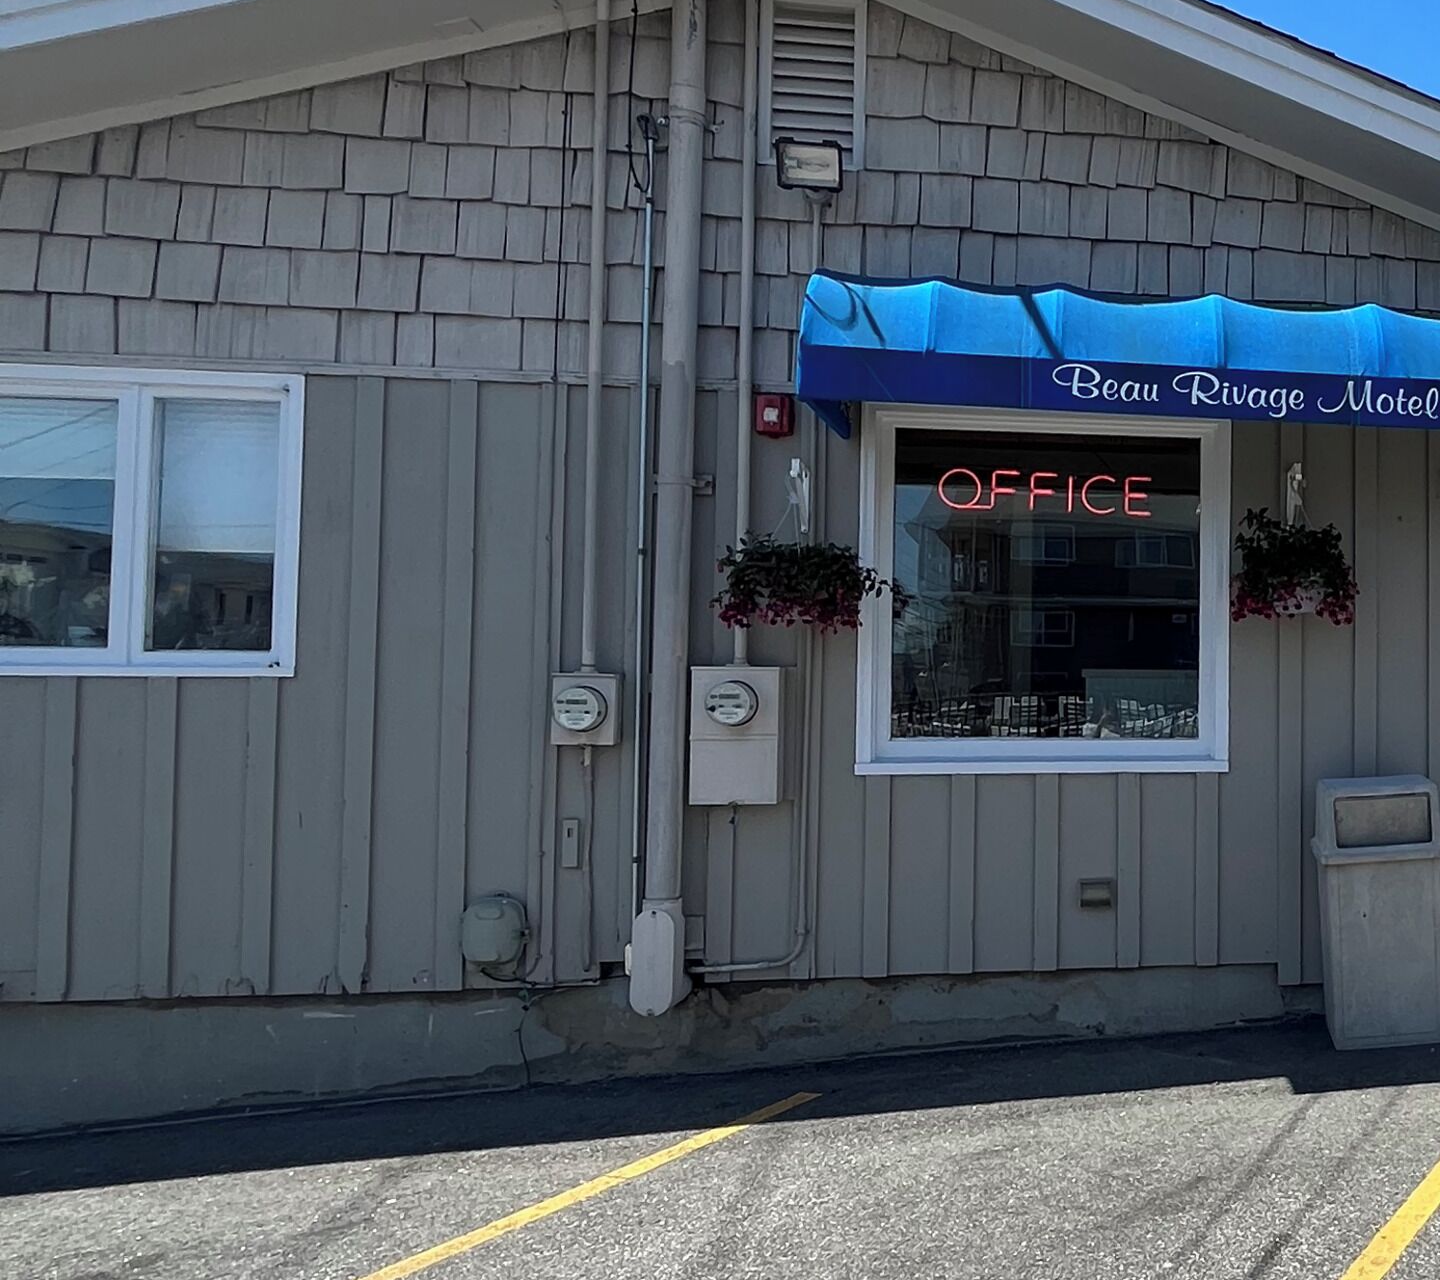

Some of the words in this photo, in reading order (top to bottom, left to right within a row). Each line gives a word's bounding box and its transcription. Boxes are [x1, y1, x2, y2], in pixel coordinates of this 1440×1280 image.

[1052, 363, 1160, 402] Beau
[1172, 371, 1305, 417] Rivage
[1316, 379, 1440, 420] Motel
[937, 468, 1153, 516] OFFICE
